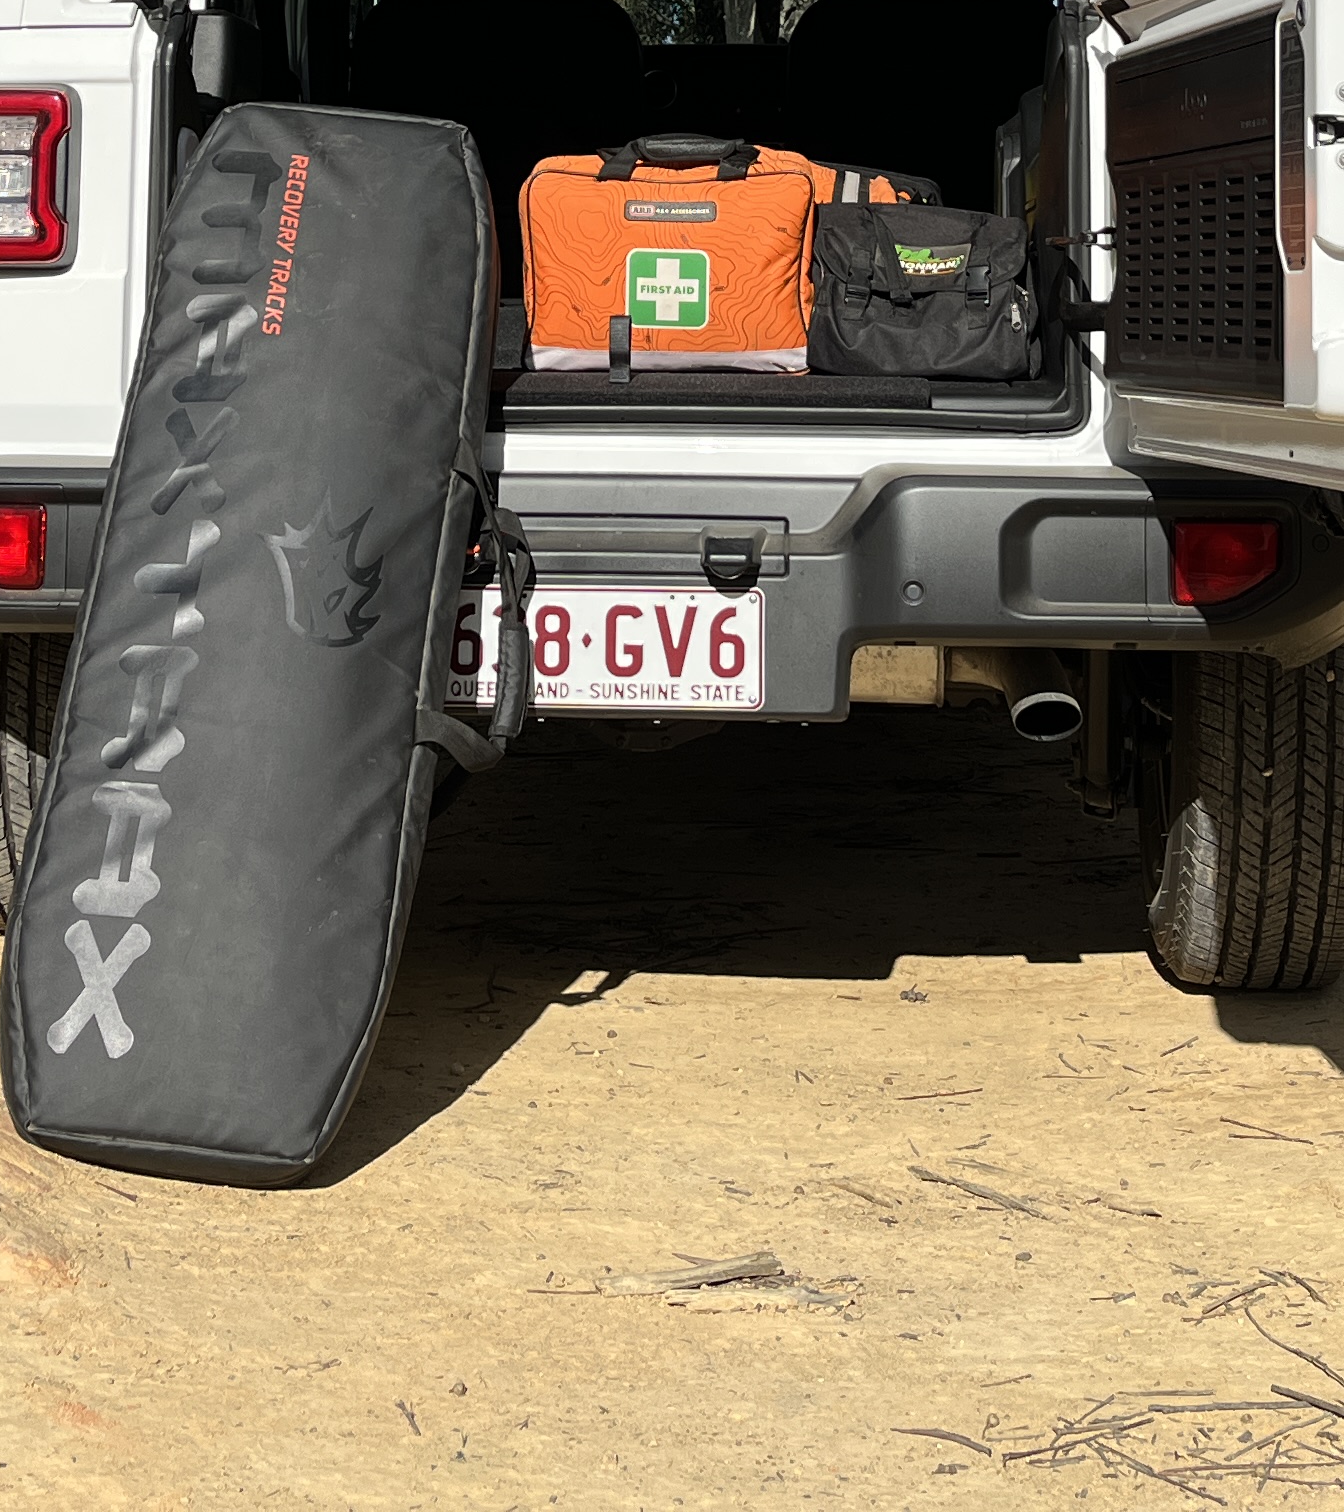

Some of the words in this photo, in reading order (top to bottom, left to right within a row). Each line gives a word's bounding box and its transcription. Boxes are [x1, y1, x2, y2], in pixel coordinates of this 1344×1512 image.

[275, 153, 310, 255] RECOVERY
[262, 258, 293, 336] TRACKS
[640, 284, 672, 294] FIRST
[673, 285, 695, 295] AID
[47, 150, 283, 1058] MAXTRAX
[450, 680, 570, 699] QUEEAND
[590, 682, 681, 701] SUNSHINE
[690, 684, 745, 701] STATE
